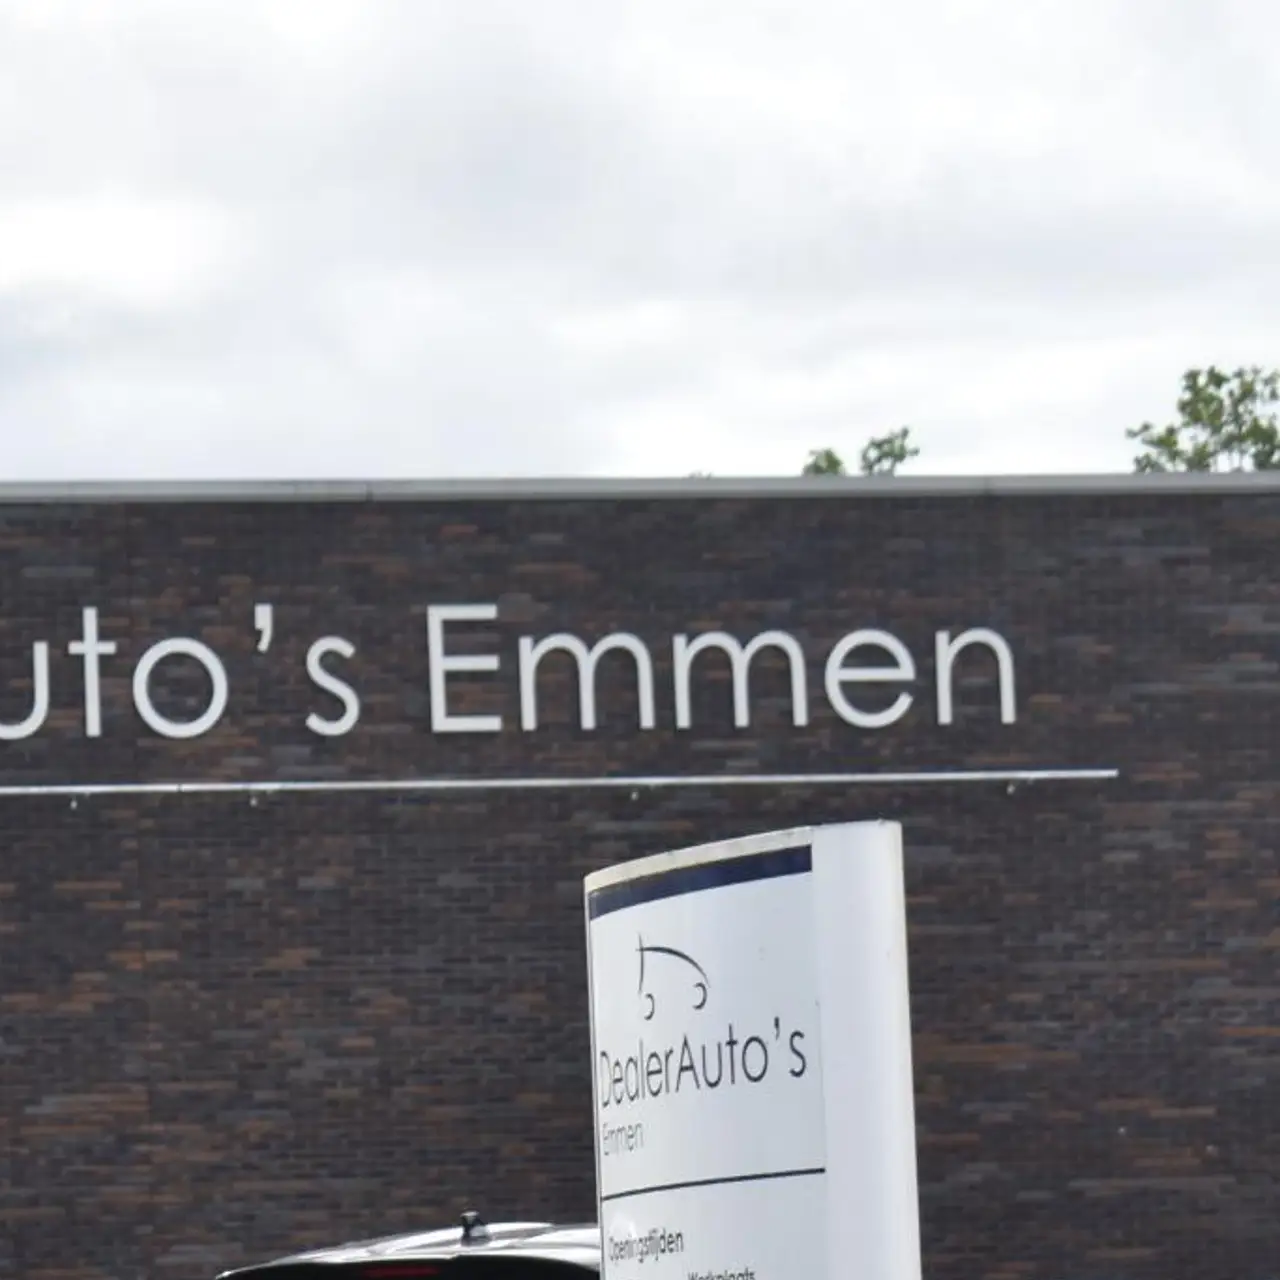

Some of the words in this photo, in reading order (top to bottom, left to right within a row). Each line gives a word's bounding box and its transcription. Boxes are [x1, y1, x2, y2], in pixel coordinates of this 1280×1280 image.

[425, 601, 1018, 735] Emmen
[600, 1016, 807, 1108] DealerAuto's
[602, 1121, 644, 1156] Emmen
